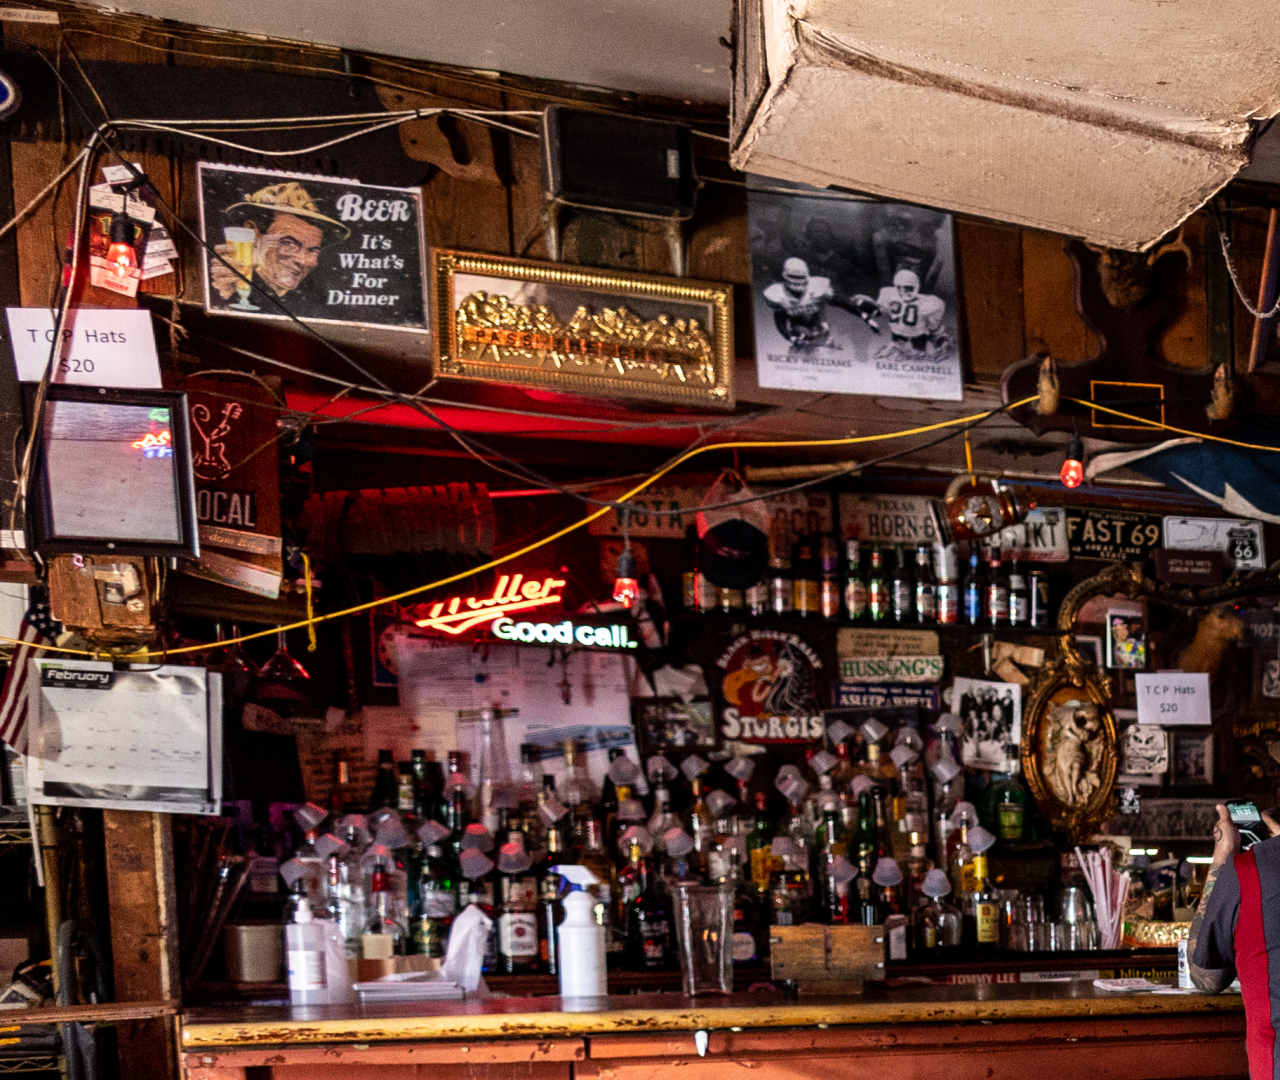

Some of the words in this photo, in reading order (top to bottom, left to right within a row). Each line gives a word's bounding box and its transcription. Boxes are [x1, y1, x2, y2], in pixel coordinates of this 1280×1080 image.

[336, 193, 410, 222] BEER
[361, 233, 393, 250] It's
[338, 252, 405, 270] What's
[352, 272, 388, 288] For
[326, 289, 400, 306] Dinner
[85, 329, 127, 343] Hats
[60, 358, 95, 373] $20
[197, 488, 256, 527] OCAL
[1066, 516, 1126, 544] FAST
[1130, 524, 1160, 547] 69
[1233, 545, 1254, 559] 66
[428, 573, 566, 620] ller
[491, 617, 574, 645] Good
[574, 624, 640, 649] call.
[46, 669, 110, 683] February
[841, 657, 941, 678] HUSSONG'S
[1174, 686, 1196, 695] Hats
[721, 708, 825, 740] STURGIS
[996, 973, 1017, 983] LEE
